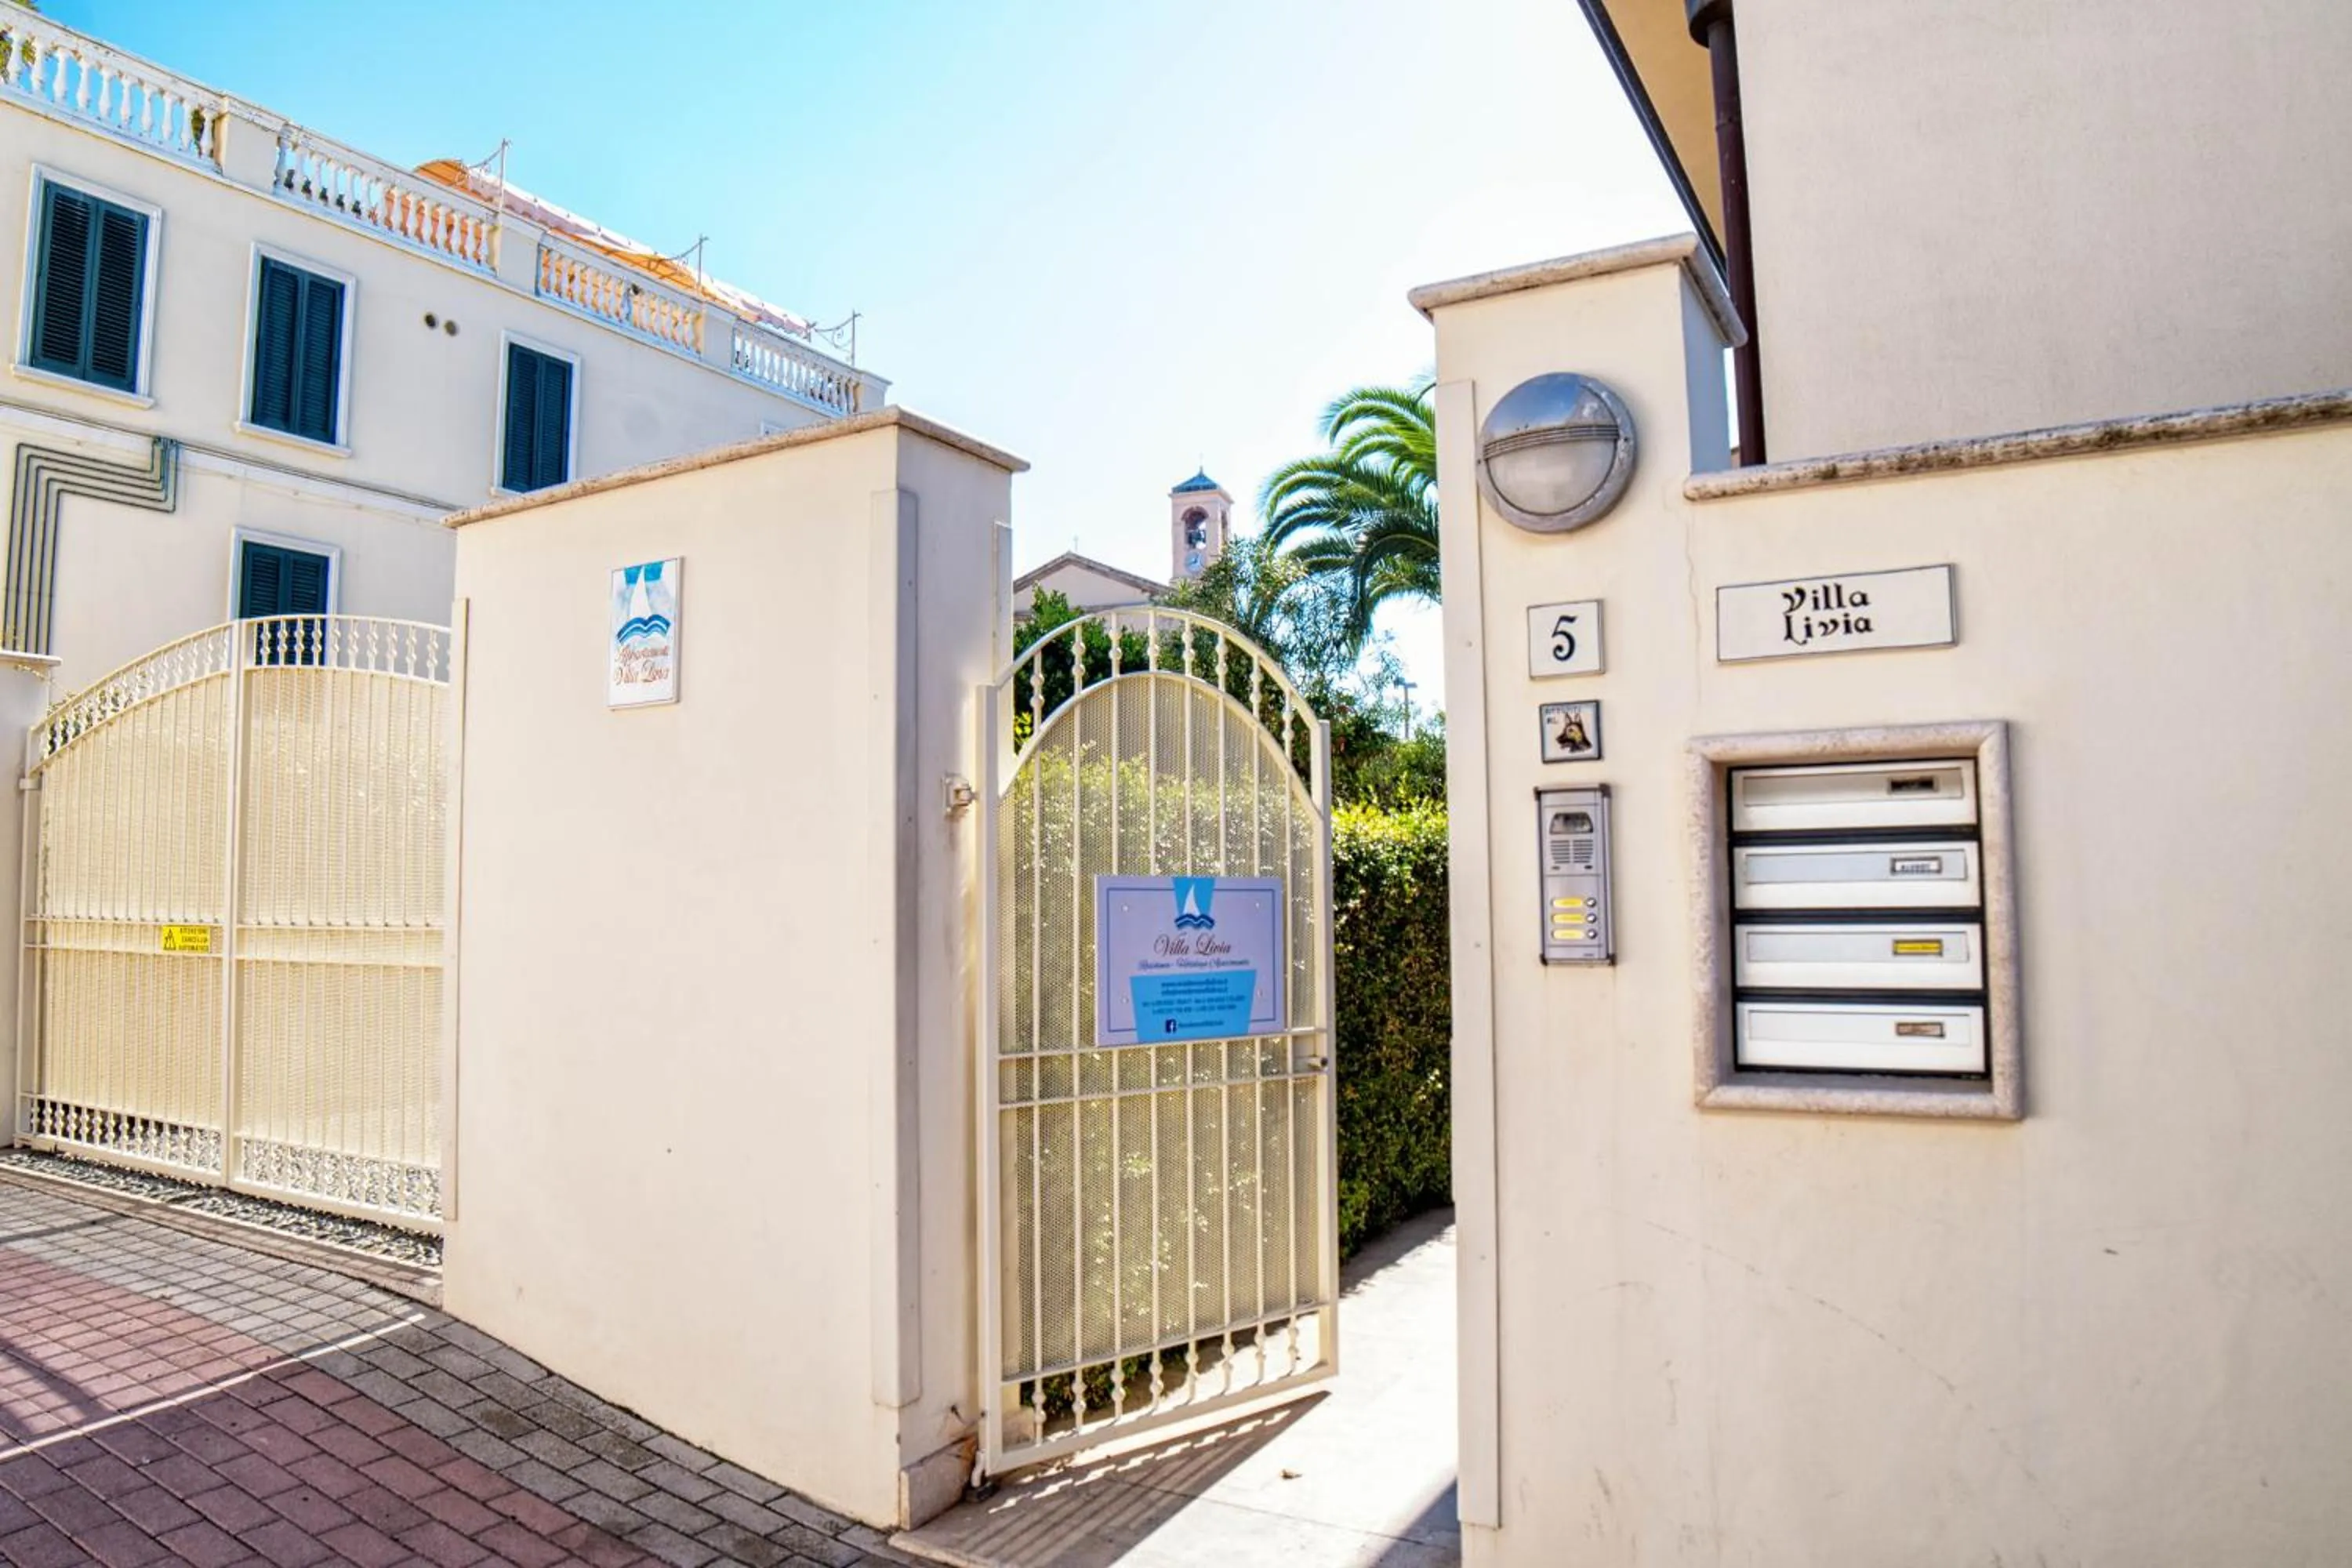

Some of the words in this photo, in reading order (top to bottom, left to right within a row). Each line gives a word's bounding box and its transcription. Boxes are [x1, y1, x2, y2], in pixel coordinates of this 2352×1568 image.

[1781, 583, 1871, 615] Villa
[1551, 614, 1579, 662] 5
[1783, 612, 1875, 646] Livia
[1153, 931, 1190, 957] Villa
[1194, 932, 1232, 956] Livia
